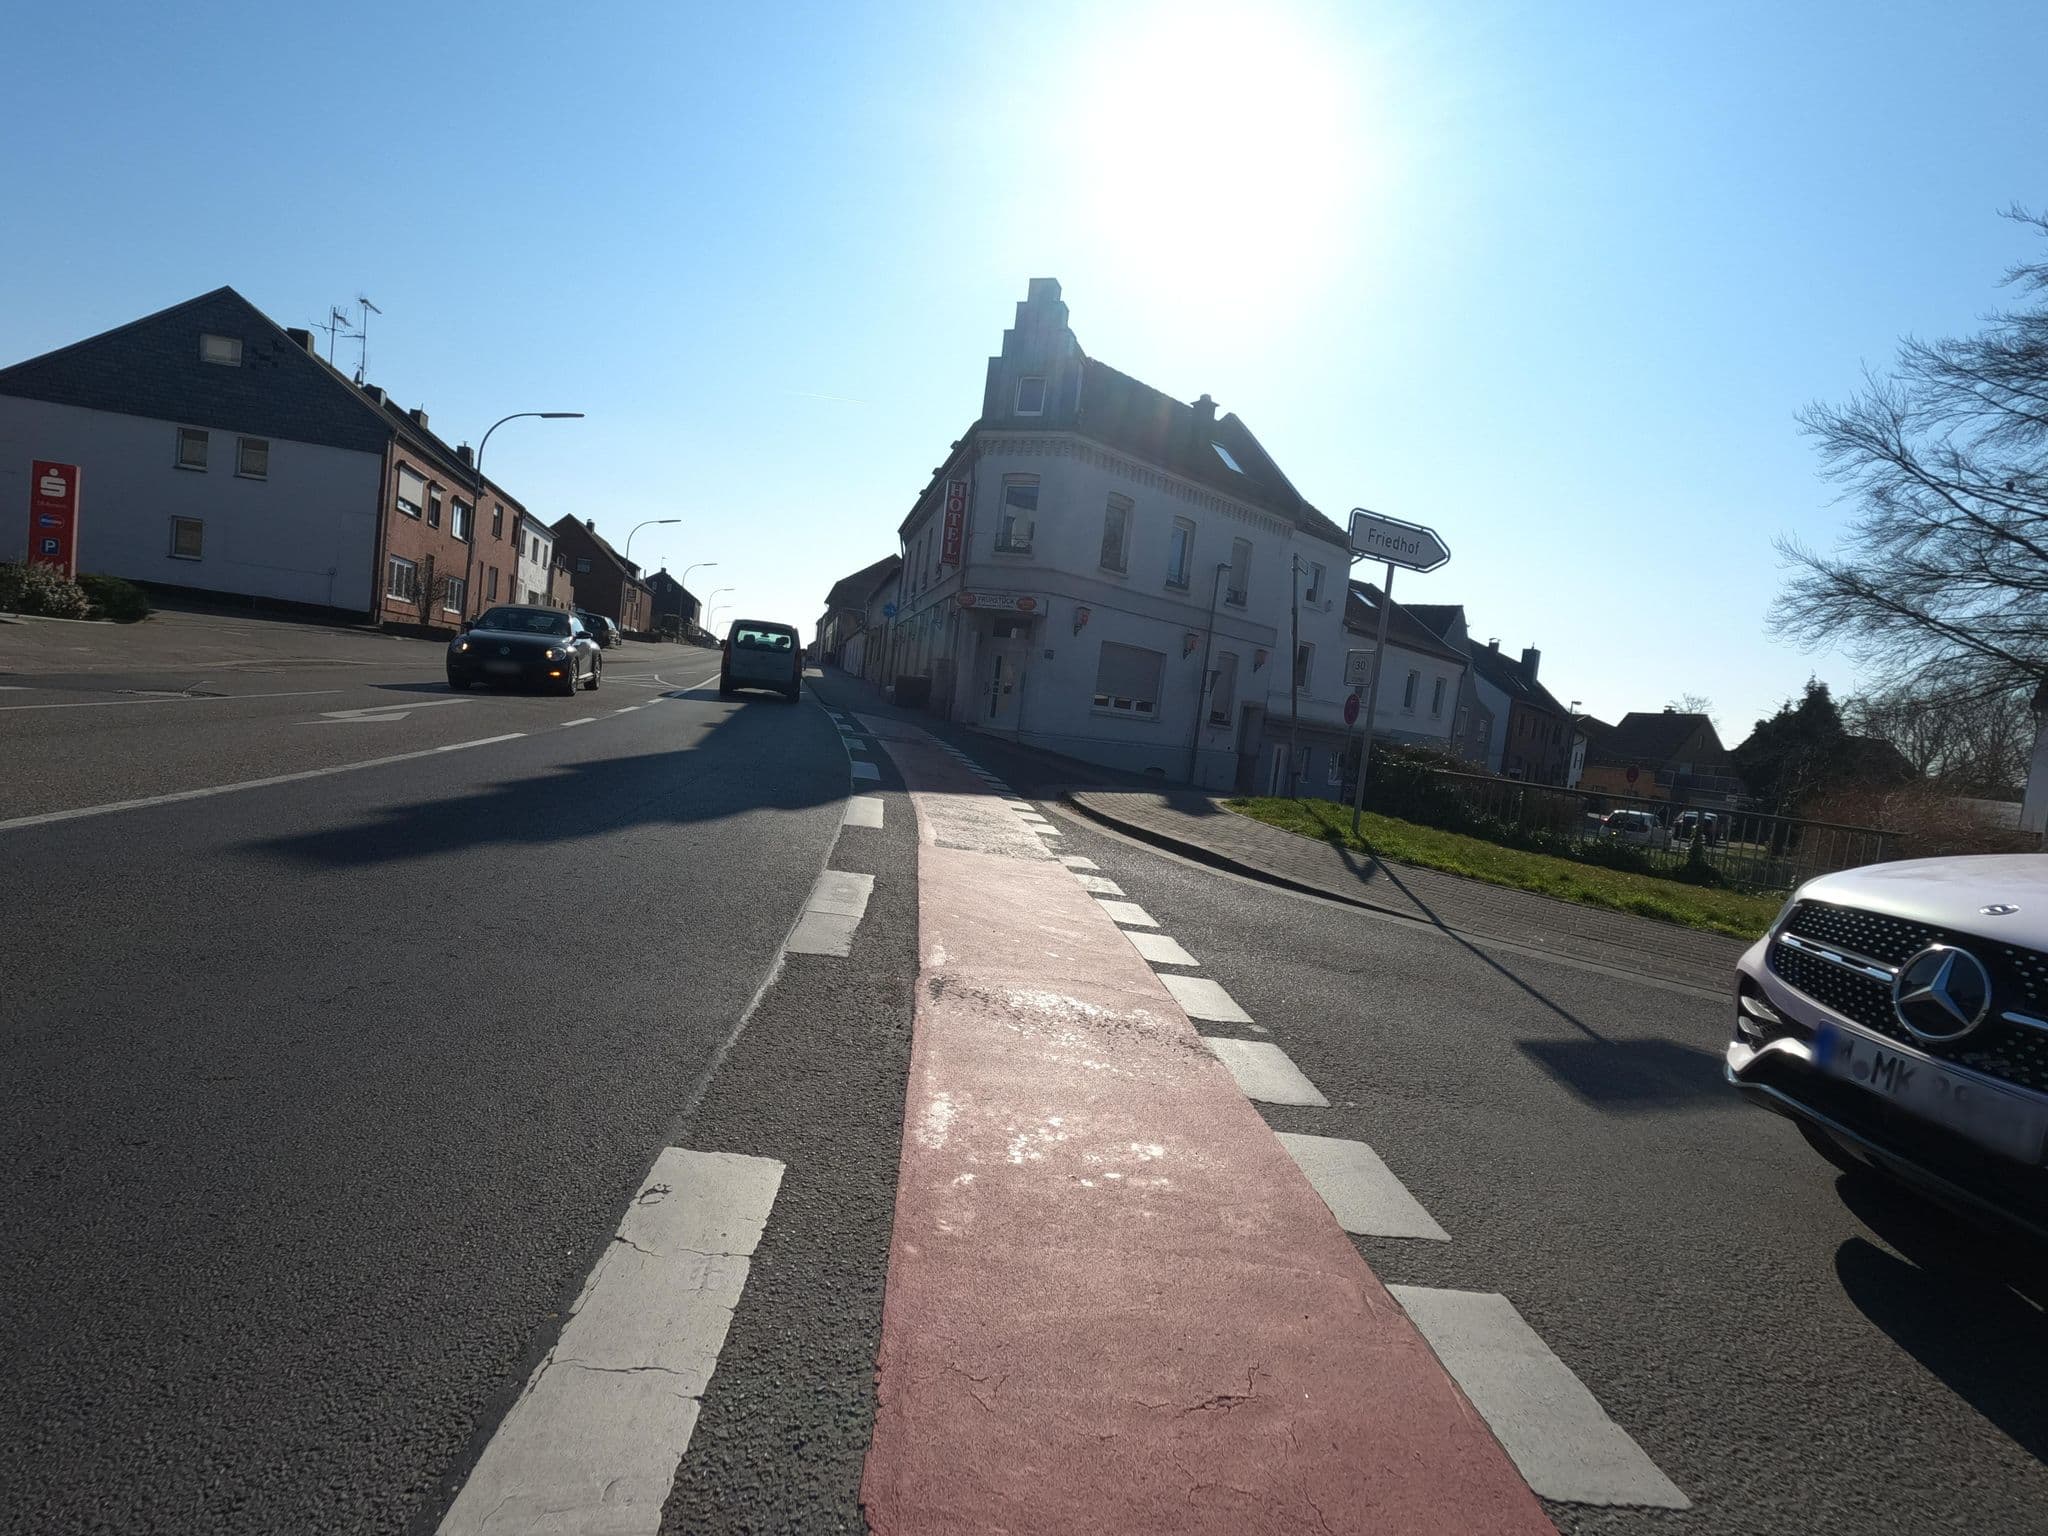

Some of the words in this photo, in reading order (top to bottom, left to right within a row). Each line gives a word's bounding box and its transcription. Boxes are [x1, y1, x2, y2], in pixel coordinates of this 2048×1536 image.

[947, 482, 963, 555] HOTEL
[44, 539, 56, 552] P
[1367, 527, 1421, 555] Friedhof
[1354, 660, 1366, 670] 30
